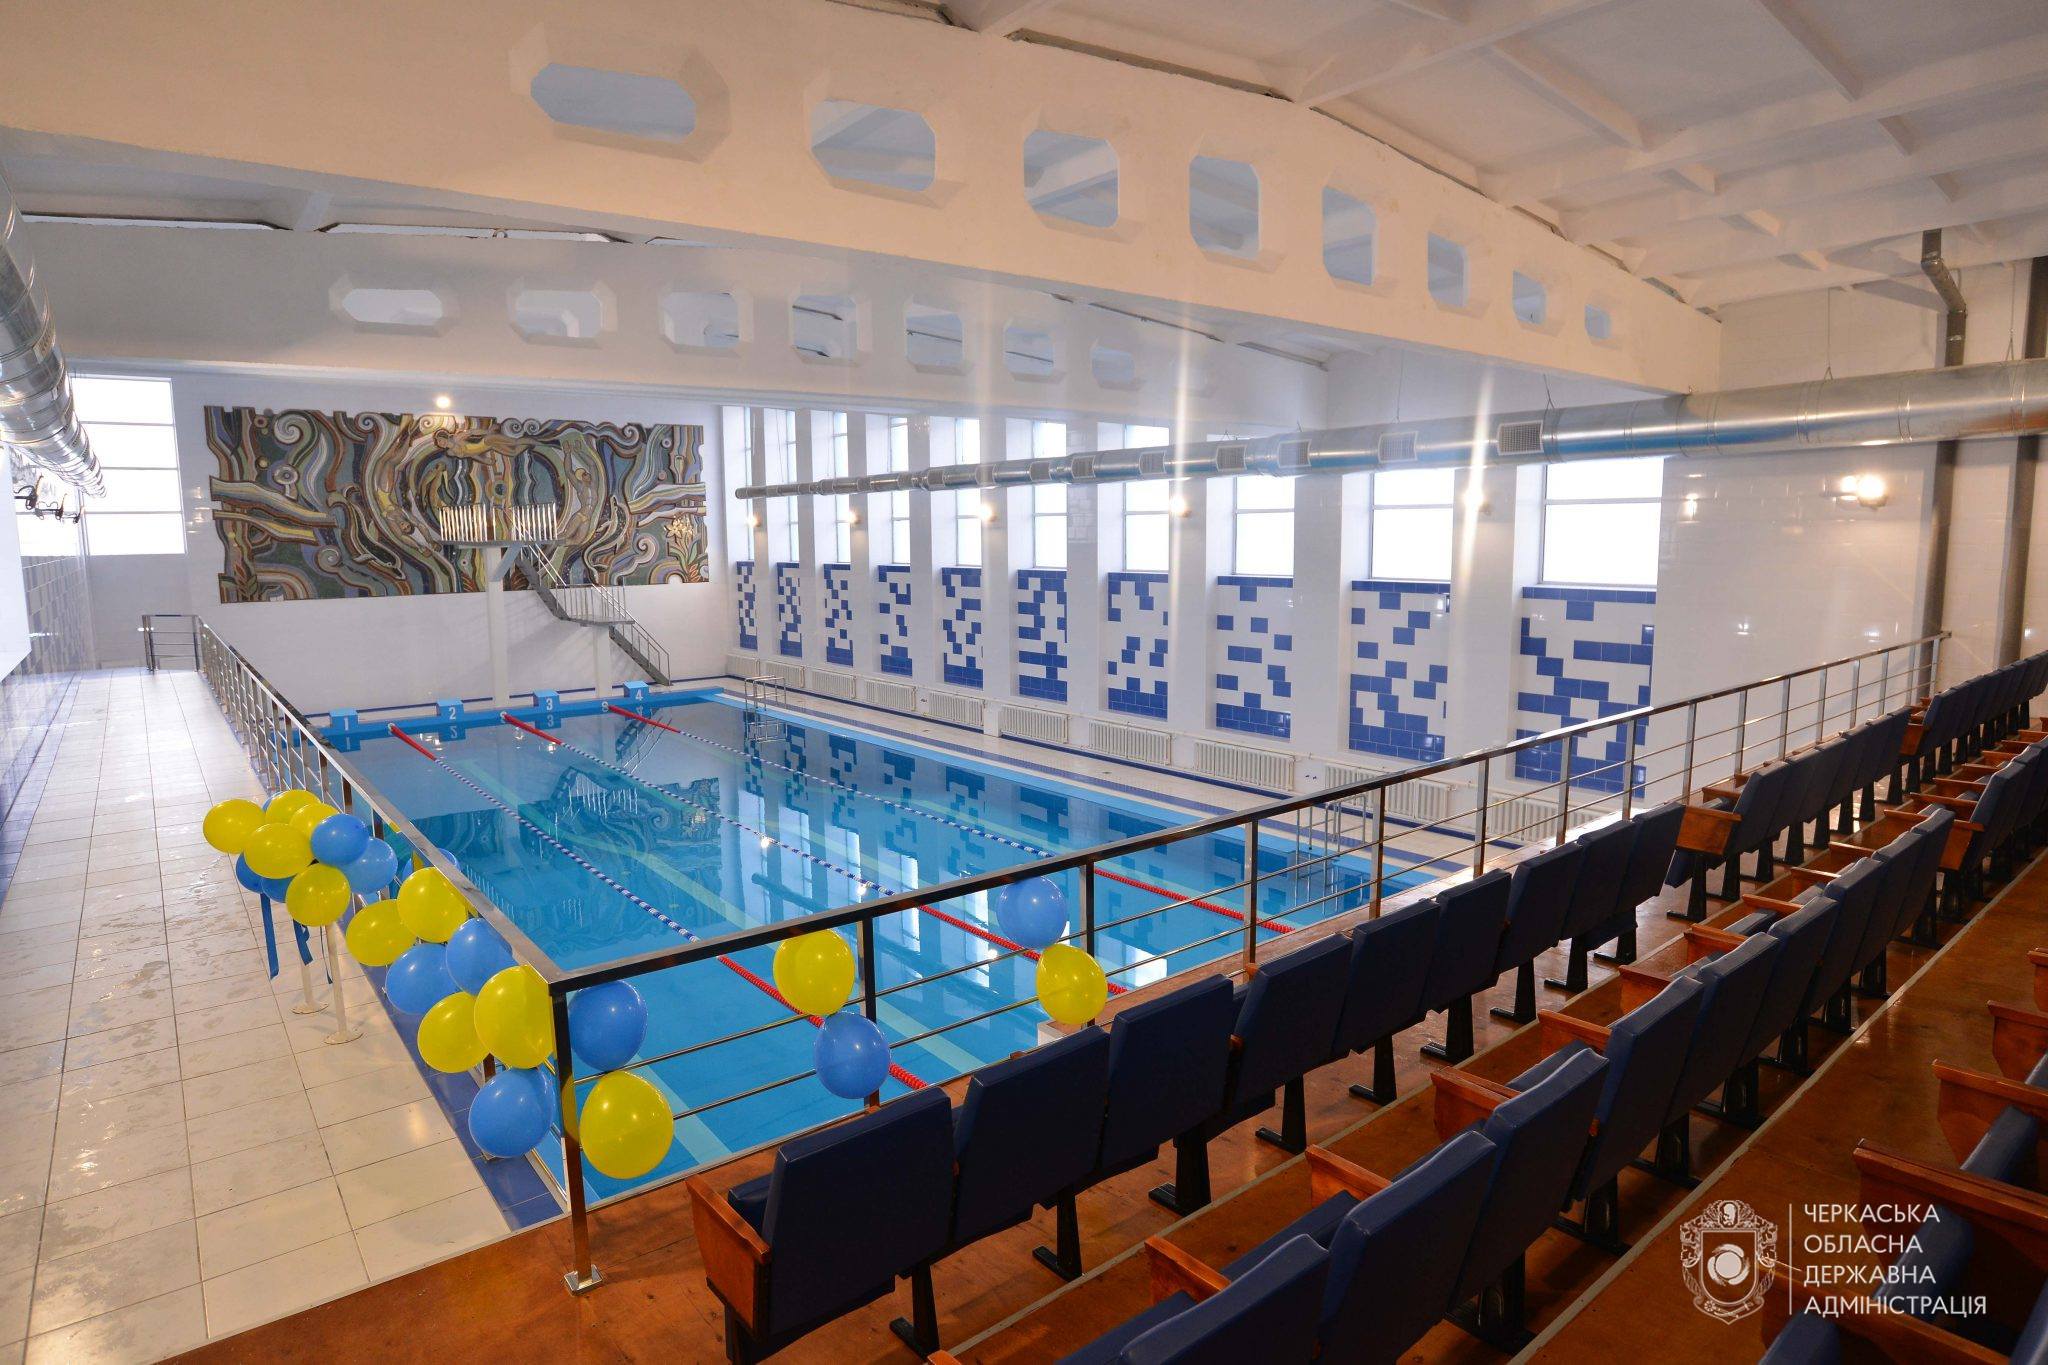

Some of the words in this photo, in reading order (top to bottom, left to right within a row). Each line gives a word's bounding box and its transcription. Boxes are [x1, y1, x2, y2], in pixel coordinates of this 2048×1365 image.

[635, 689, 643, 701] 4
[546, 698, 553, 711] 3
[449, 706, 456, 720] 2
[344, 717, 349, 731] 1
